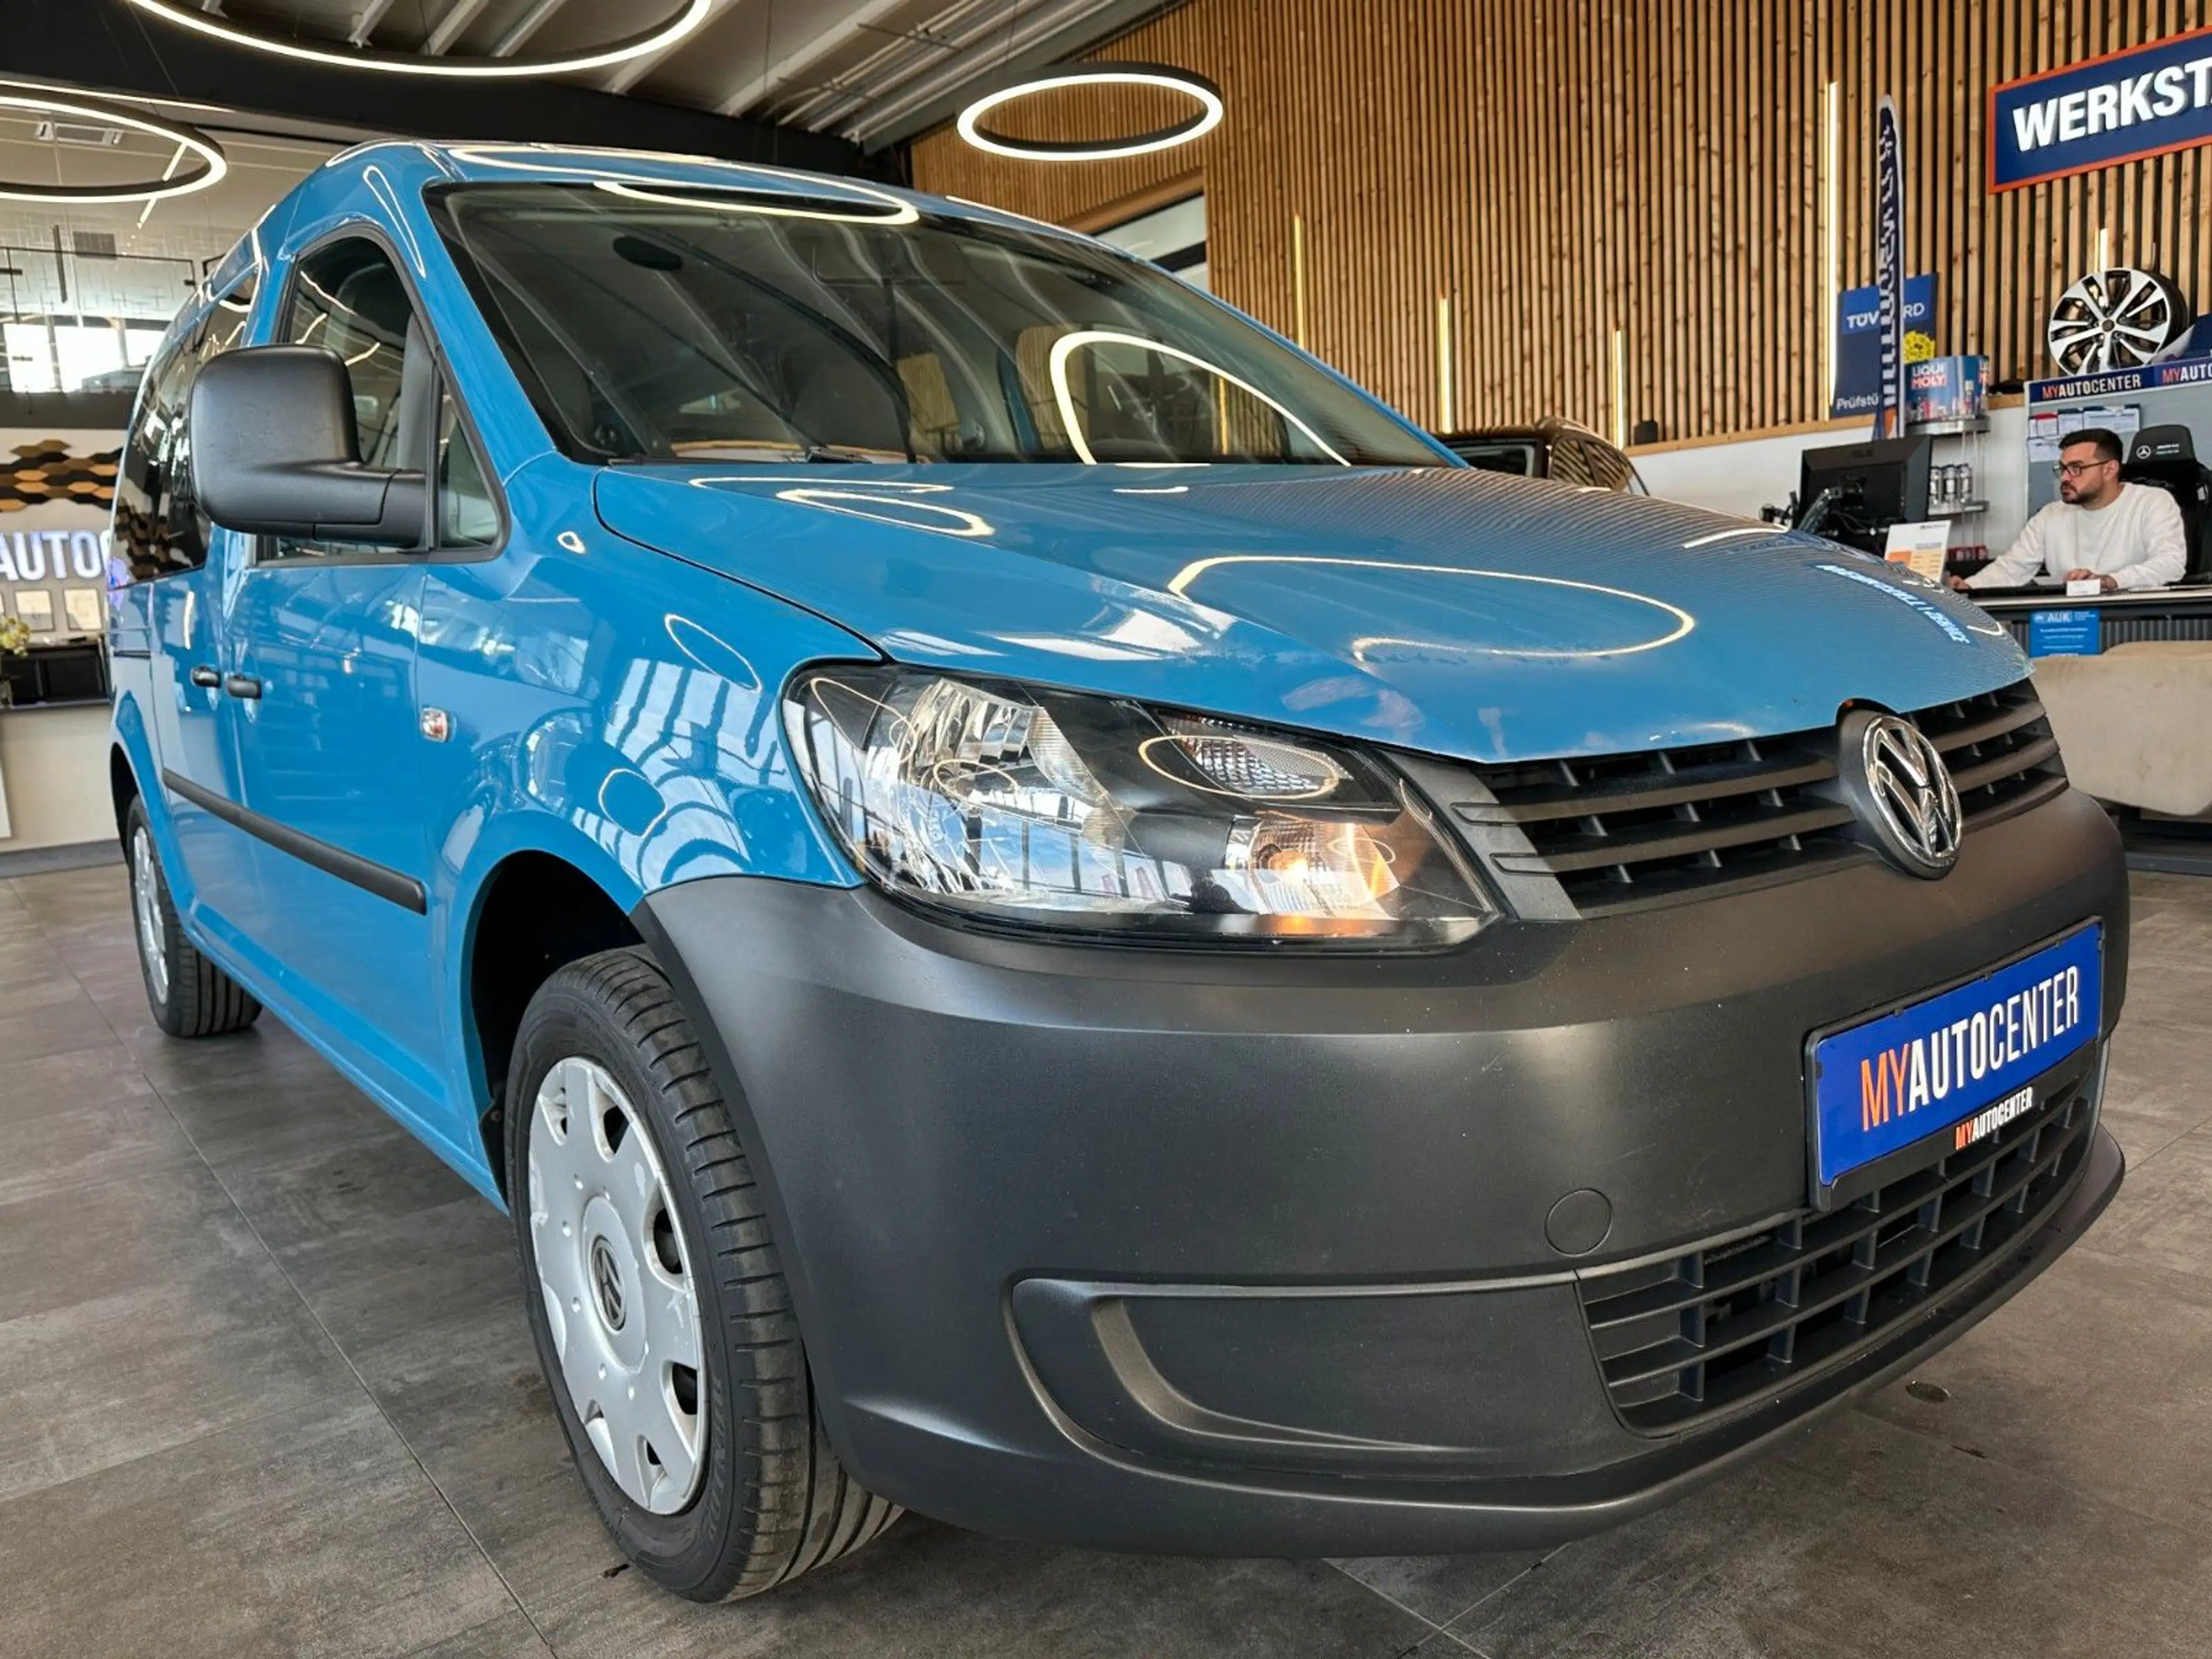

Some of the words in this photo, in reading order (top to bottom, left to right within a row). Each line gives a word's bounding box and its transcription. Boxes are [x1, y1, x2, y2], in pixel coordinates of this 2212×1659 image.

[2013, 56, 2212, 152] WERKST
[1847, 310, 1880, 329] TÜV
[1903, 302, 1925, 319] RD
[1836, 392, 1879, 410] Prüfstü
[2042, 374, 2141, 400] MYAUTOCENTER
[1861, 965, 2079, 1132] MYAUTOCENTER
[1956, 1086, 2033, 1150] MYAUTOCENTER
